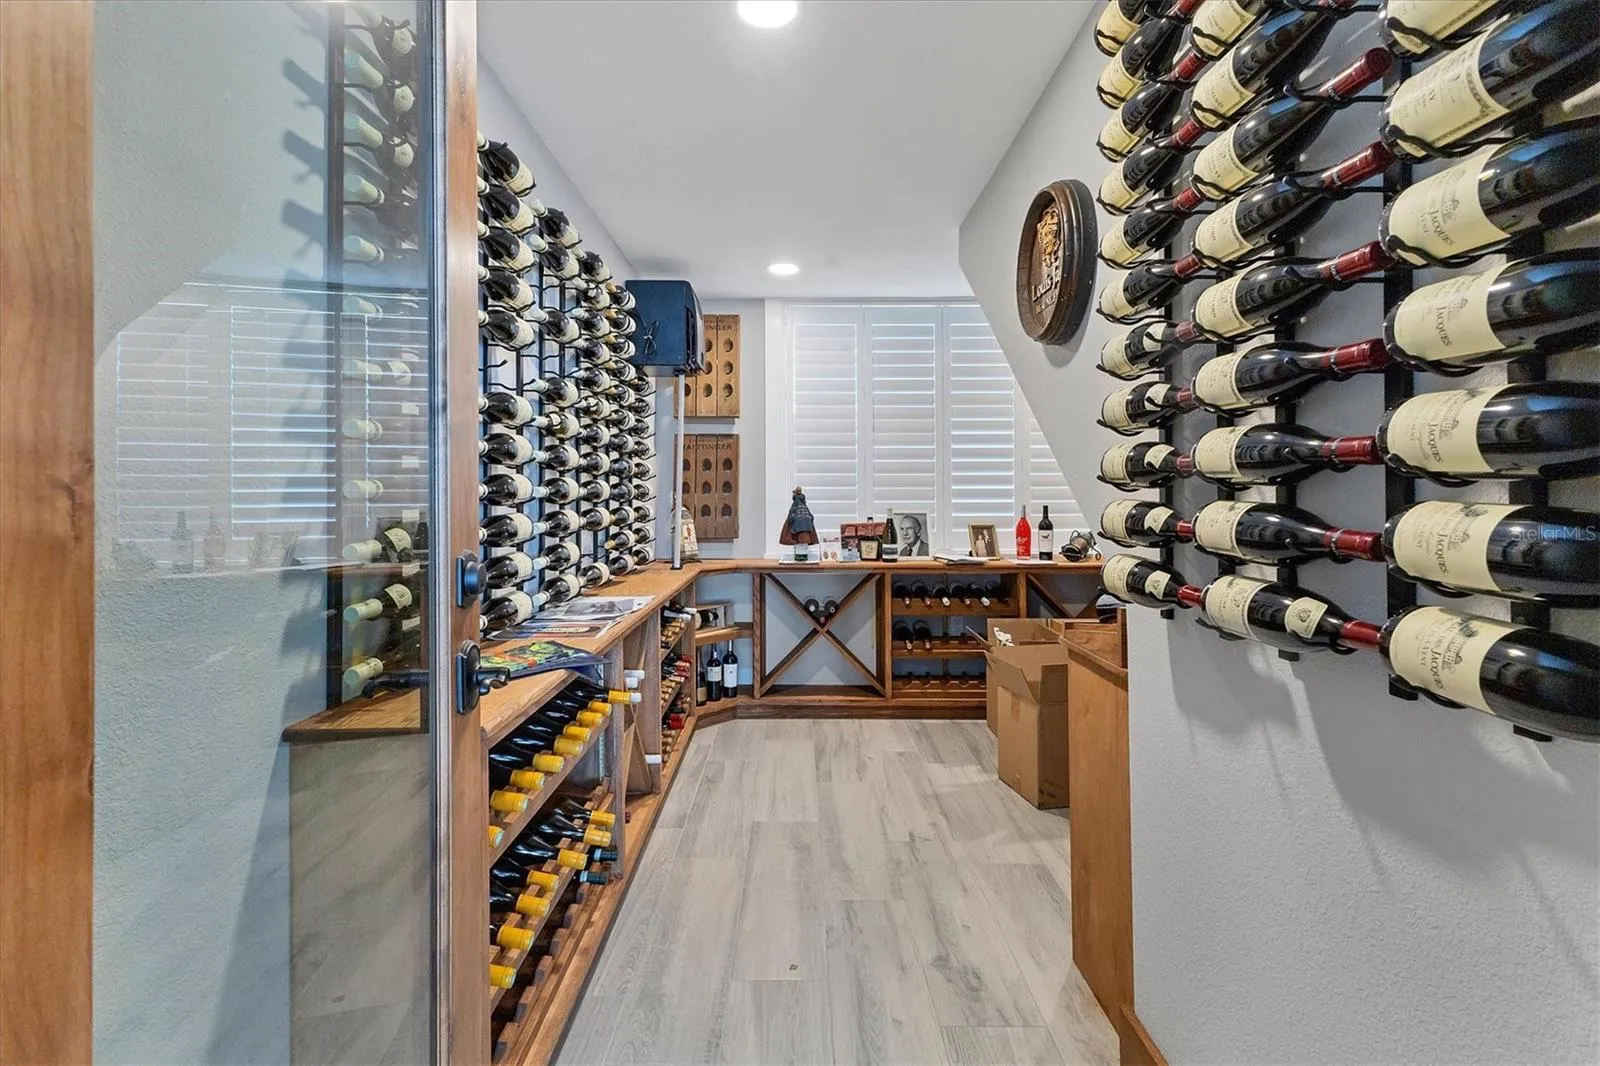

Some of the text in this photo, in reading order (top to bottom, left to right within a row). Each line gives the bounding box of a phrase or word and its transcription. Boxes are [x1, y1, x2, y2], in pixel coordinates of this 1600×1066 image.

[1435, 305, 1454, 347] JACQUES
[1427, 423, 1444, 463] JACQUES
[1435, 531, 1450, 573] JACQUES
[1430, 647, 1446, 690] JACQUES
